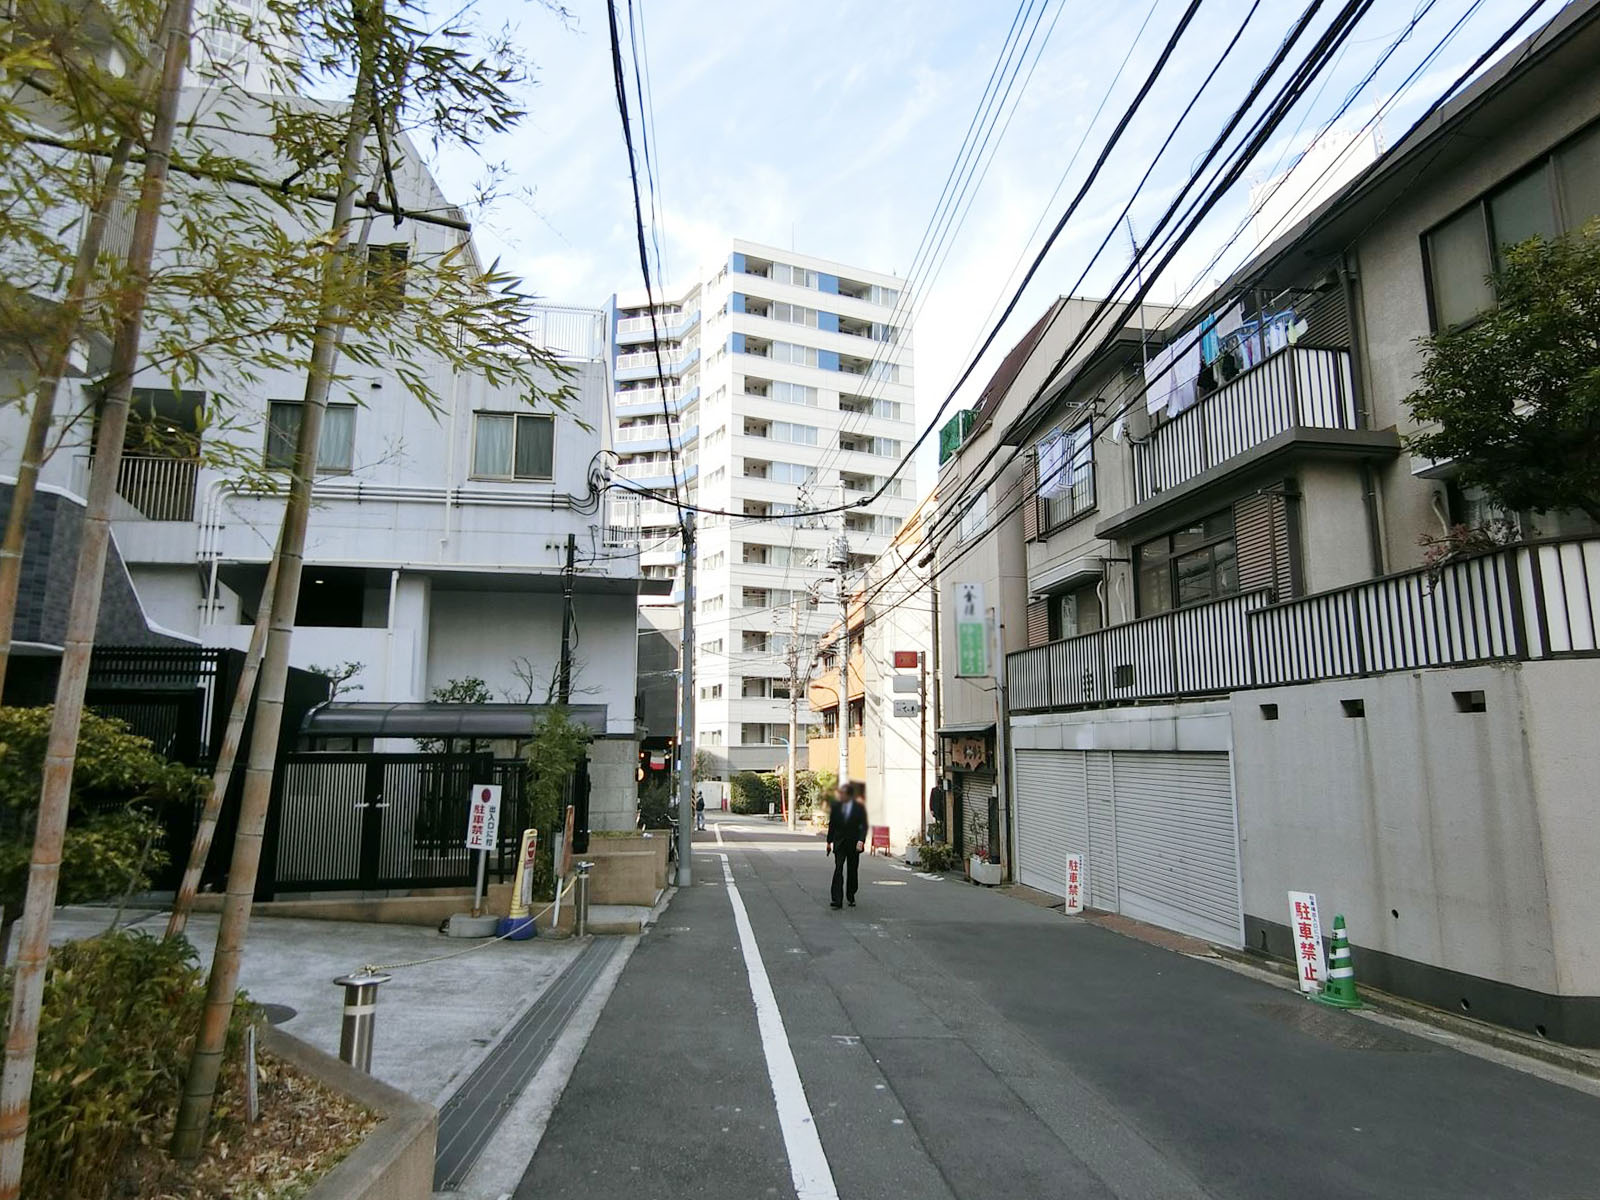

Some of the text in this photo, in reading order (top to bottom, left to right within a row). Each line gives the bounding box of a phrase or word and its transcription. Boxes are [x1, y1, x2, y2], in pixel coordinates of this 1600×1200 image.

[471, 804, 486, 846] 駐車禁止
[1068, 859, 1079, 909] 駐車禁止
[1295, 902, 1318, 981] 駐車禁止
